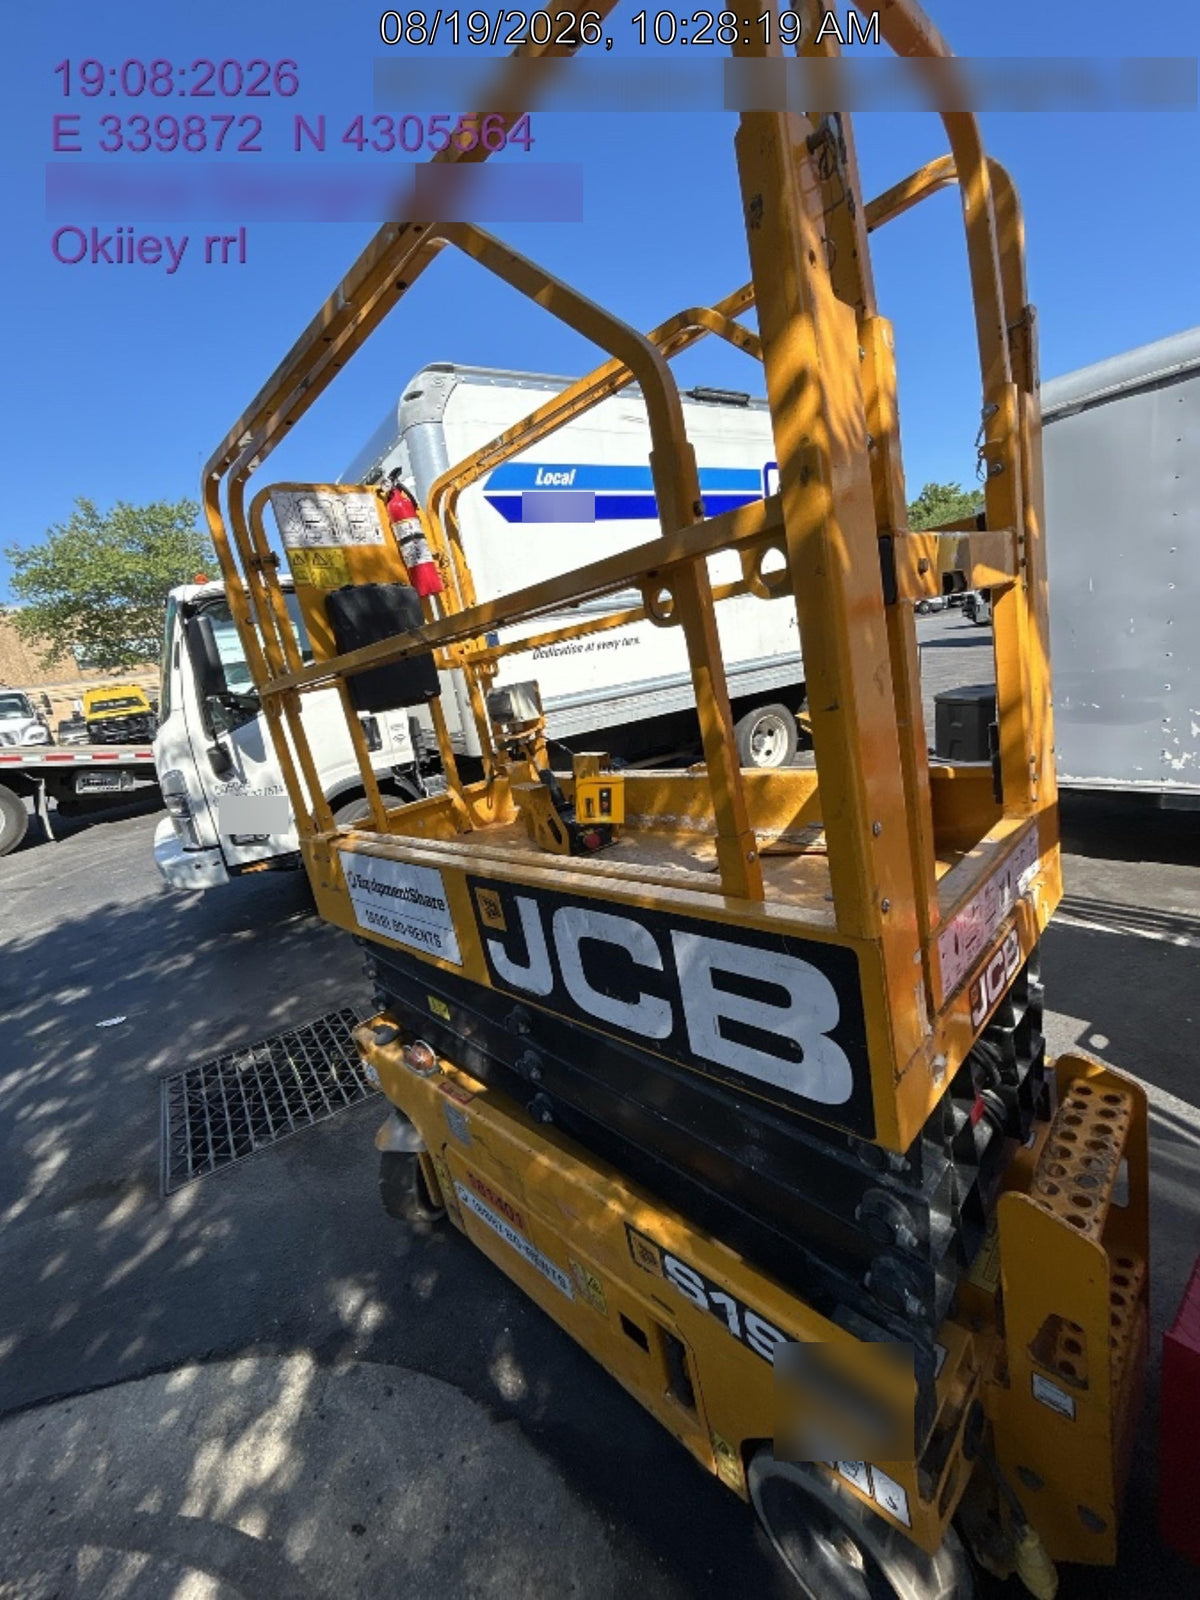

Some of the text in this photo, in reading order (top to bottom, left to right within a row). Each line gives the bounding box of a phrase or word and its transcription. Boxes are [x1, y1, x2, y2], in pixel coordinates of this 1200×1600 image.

[535, 468, 577, 487] Local
[486, 895, 853, 1105] JCB
[972, 928, 1020, 1027] JCB
